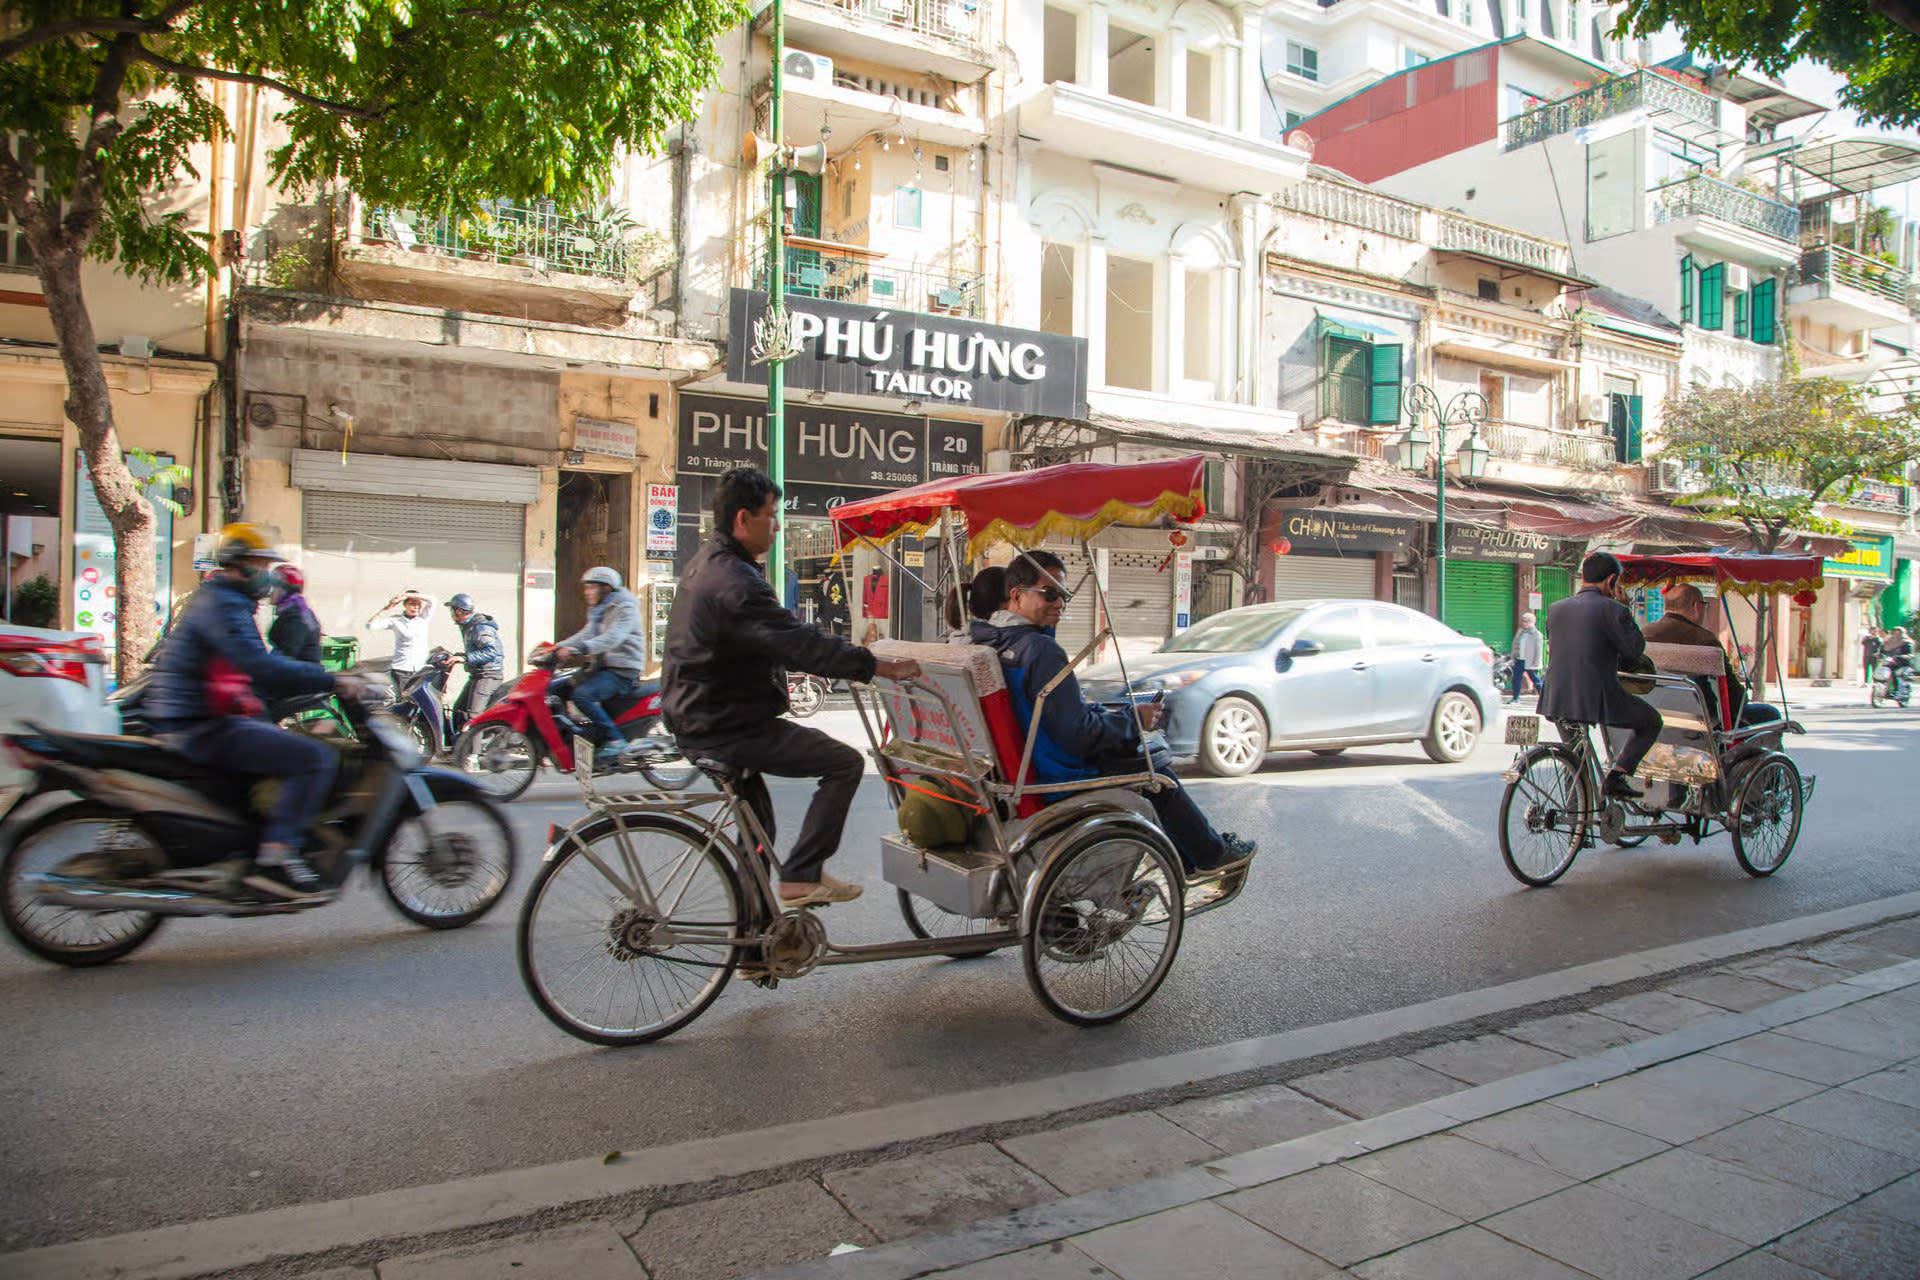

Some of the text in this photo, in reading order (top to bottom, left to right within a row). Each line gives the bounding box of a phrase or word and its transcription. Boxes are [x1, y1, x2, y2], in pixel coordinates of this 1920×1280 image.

[788, 311, 1047, 381] PHÚ HƯNG
[870, 369, 973, 400] TAILOR
[798, 421, 917, 464] HƯNG
[943, 436, 968, 453] 20
[687, 456, 700, 467] 20
[703, 456, 732, 471] Tràng
[931, 461, 959, 473] TRÀNG
[870, 470, 918, 483] 38.250066
[651, 484, 676, 497] BÁN
